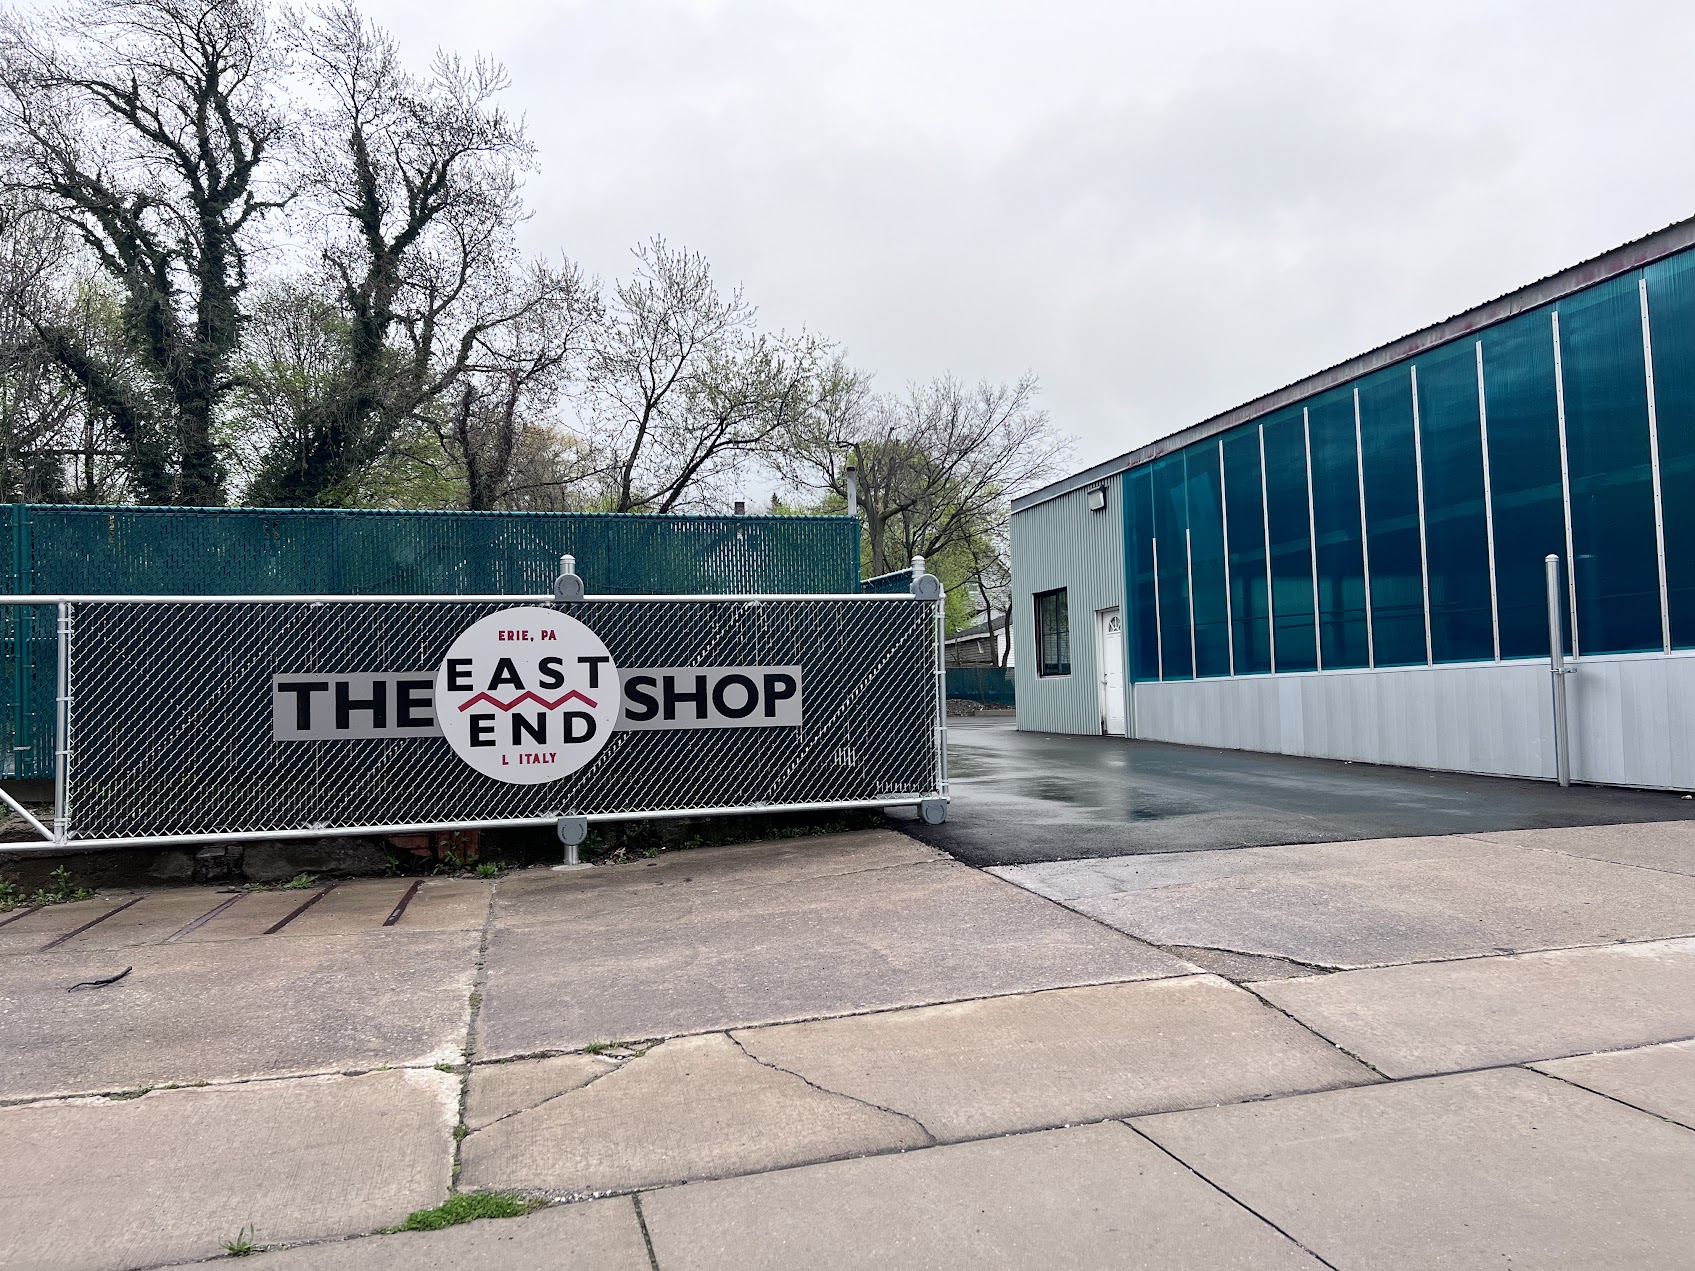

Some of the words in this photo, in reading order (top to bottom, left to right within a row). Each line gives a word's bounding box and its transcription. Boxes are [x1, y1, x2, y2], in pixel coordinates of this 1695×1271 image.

[498, 630, 534, 642] ERIE,
[541, 630, 557, 641] PA
[446, 656, 610, 692] EAST
[277, 680, 434, 731] THE
[624, 674, 797, 721] SHOP
[469, 711, 597, 748] END
[502, 754, 509, 765] L
[519, 753, 557, 765] ITALY
